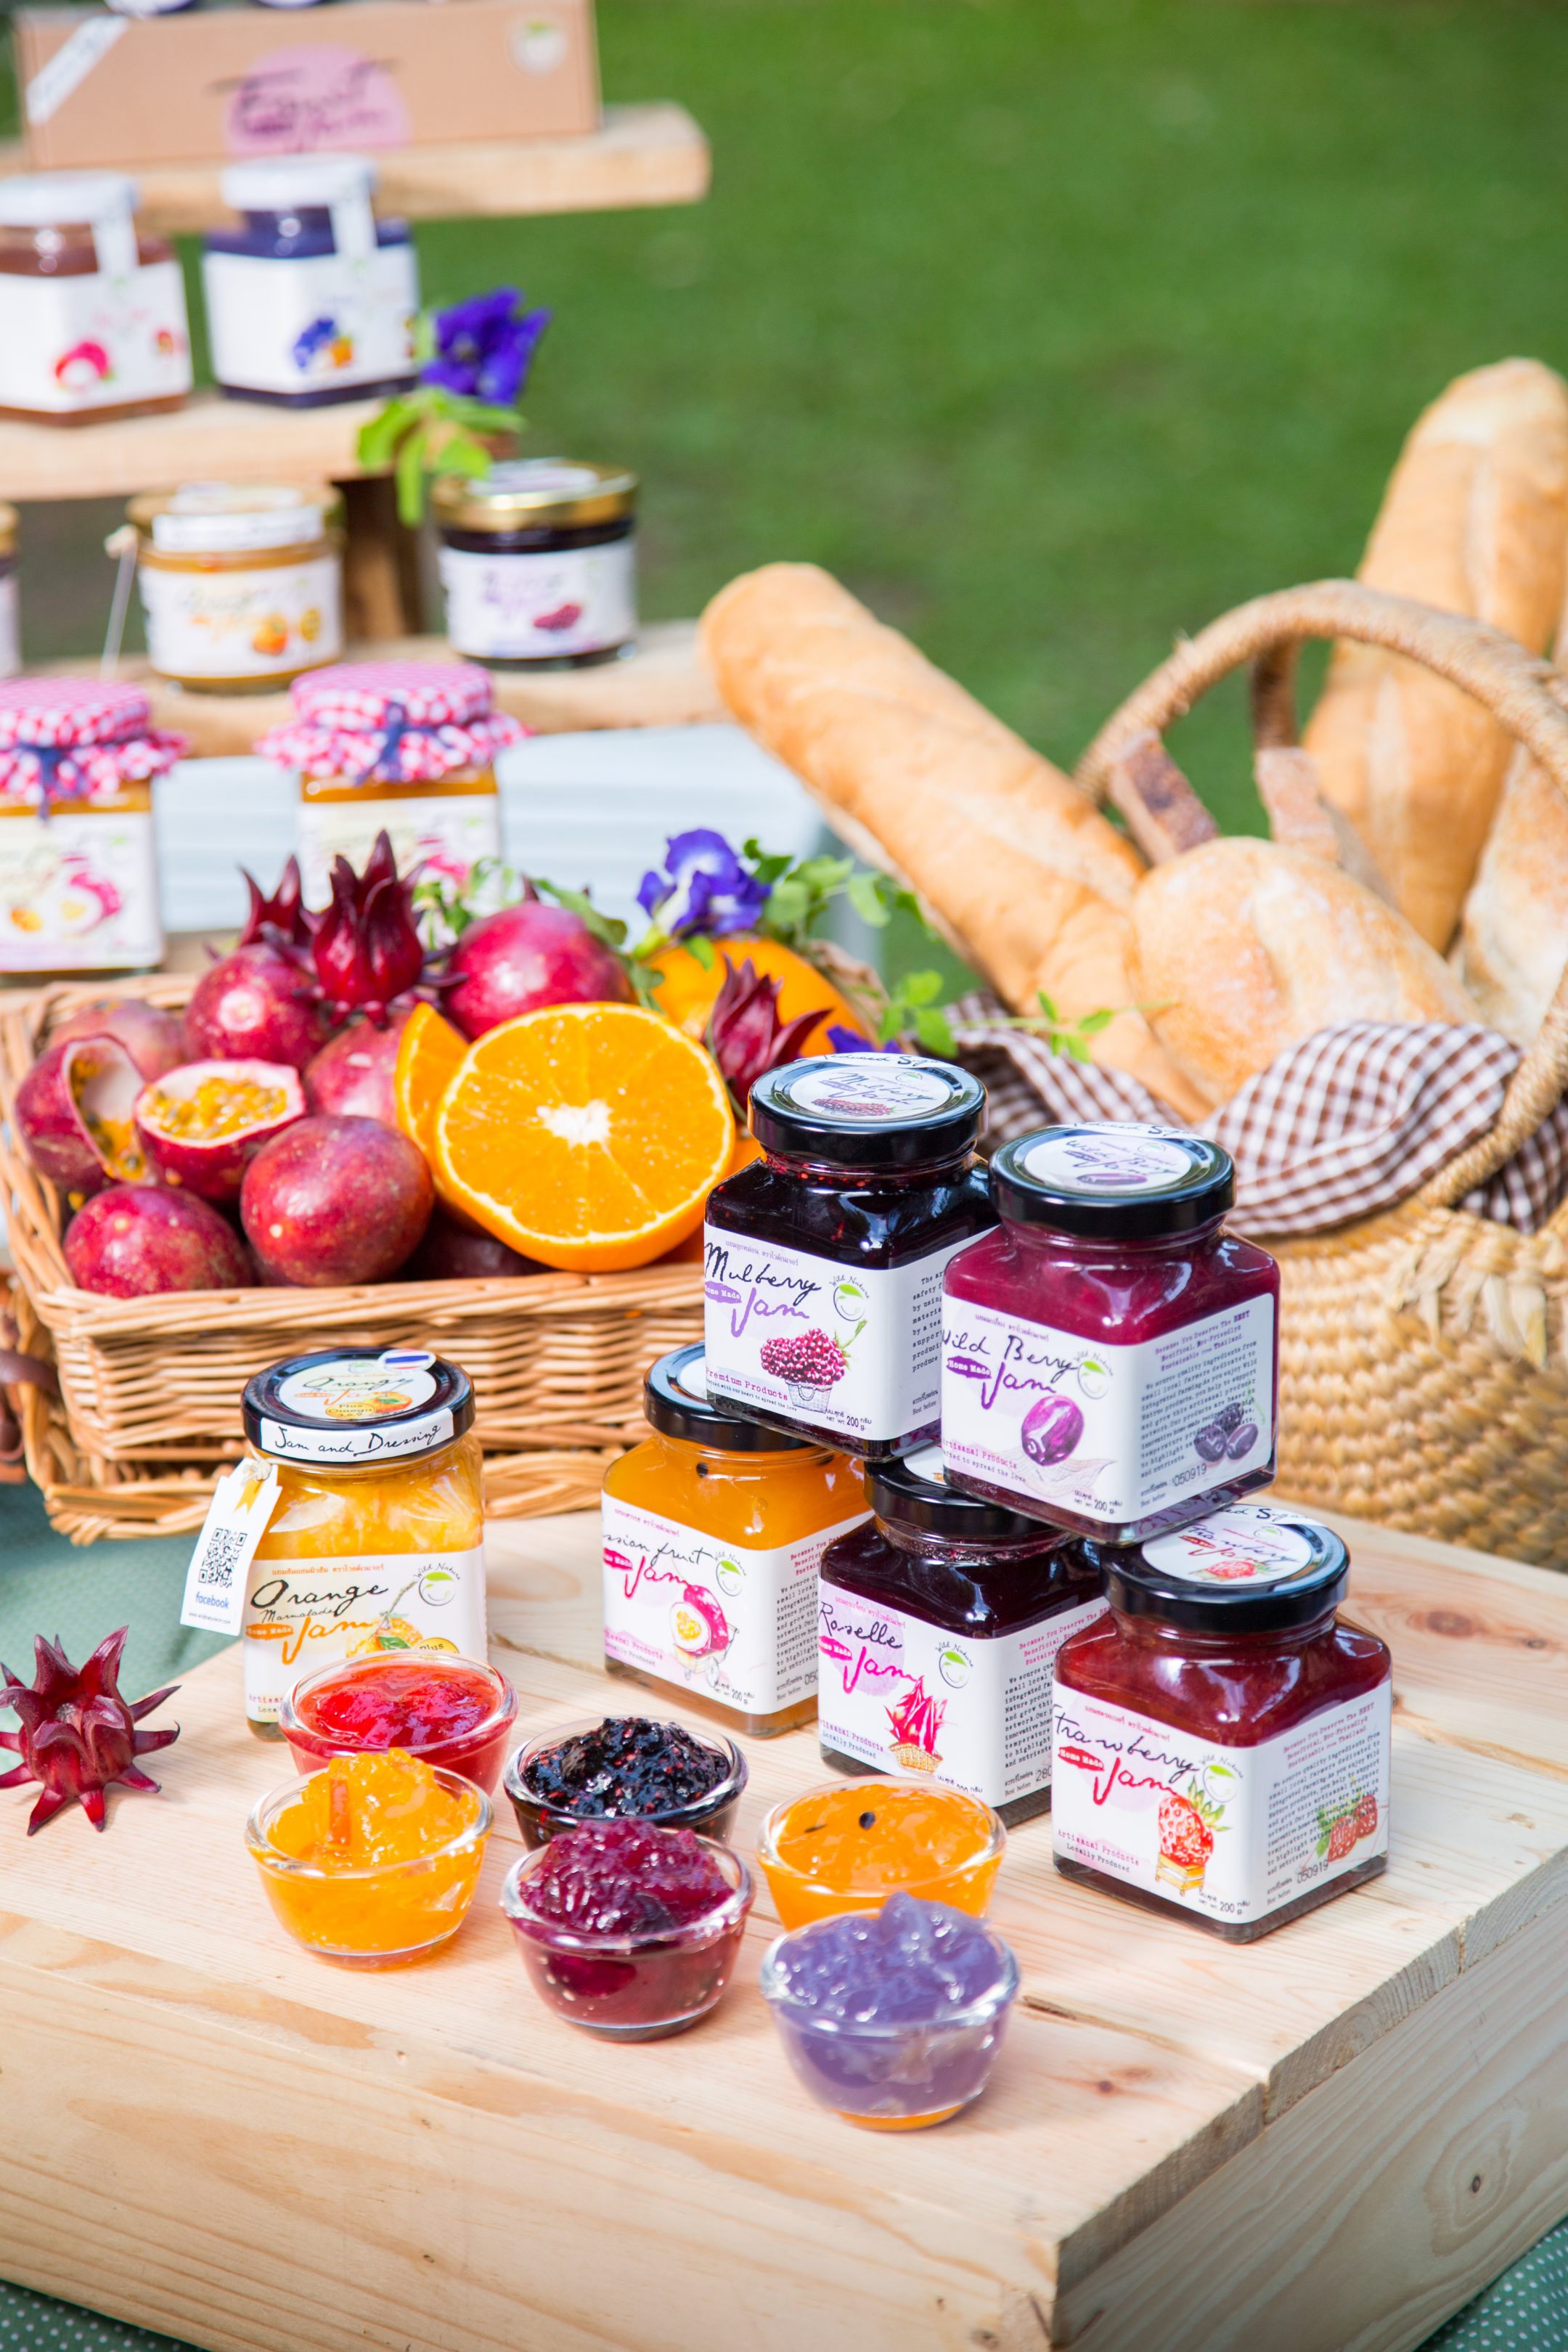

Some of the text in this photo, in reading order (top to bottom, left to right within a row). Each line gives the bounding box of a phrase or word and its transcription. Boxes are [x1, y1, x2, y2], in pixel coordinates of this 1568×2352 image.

[704, 1242, 821, 1306] Mulberry
[920, 1275, 933, 1285] The
[721, 1289, 740, 1302] Made
[829, 1275, 870, 1299] Wild Nature
[912, 1286, 936, 1301] safety
[730, 1287, 809, 1338] Jam
[912, 1304, 921, 1312] by
[912, 1307, 942, 1324] materia
[1181, 1335, 1193, 1344] You
[1220, 1320, 1232, 1328] The
[1233, 1310, 1250, 1323] BEST
[912, 1355, 938, 1373] produce
[942, 1329, 1078, 1384] Wild Berry
[948, 1357, 991, 1379] Home Made
[303, 1376, 415, 1391] Orange
[745, 1381, 788, 1401] Products
[981, 1362, 1056, 1410] Jam
[761, 1397, 777, 1405] spread
[912, 1400, 936, 1416] Best before
[846, 1415, 859, 1428] 200
[274, 1424, 441, 1457] Jam and Dressing
[946, 1441, 1017, 1469] rtisanal Products
[971, 1461, 995, 1473] spread
[997, 1469, 1008, 1477] the
[1174, 1462, 1207, 1487] 050919
[1094, 1498, 1107, 1512] 200
[602, 1534, 713, 1569] ssion fruit
[790, 1541, 827, 1561] Because You
[413, 1562, 461, 1581] Wild Nature
[624, 1556, 692, 1598] Jam
[776, 1583, 816, 1604] small local
[789, 1577, 810, 1591] source
[195, 1592, 230, 1609] facebook
[250, 1579, 388, 1617] Orange
[777, 1593, 810, 1614] integrated
[258, 1609, 336, 1623] Marmalade
[777, 1609, 797, 1622] Nature
[789, 1614, 804, 1627] grow
[819, 1601, 902, 1650] Roselle
[281, 1617, 372, 1666] Jam
[777, 1631, 807, 1649] innovative
[1018, 1636, 1045, 1650] Because
[1046, 1629, 1058, 1638] You
[1058, 1618, 1085, 1633] Deserve
[776, 1635, 817, 1658] temperature
[785, 1643, 818, 1662] highlight
[833, 1644, 852, 1658] Made
[935, 1641, 974, 1668] Wild Nature
[1024, 1637, 1062, 1657] Beneficial,
[843, 1646, 919, 1694] Jam
[1018, 1667, 1041, 1681] source
[1005, 1673, 1048, 1695] small local
[1005, 1684, 1042, 1704] integrated
[249, 1694, 282, 1703] Artisa
[731, 1689, 743, 1702] 200
[1005, 1690, 1052, 1714] Nature produc
[1005, 1706, 1036, 1723] and grow
[820, 1719, 883, 1752] rtisanal Products
[1005, 1723, 1038, 1741] innovative
[1005, 1728, 1050, 1749] temperature
[822, 1731, 876, 1759] Locally Produced
[1015, 1736, 1050, 1755] highlight
[1053, 1704, 1200, 1784] trawberry
[1005, 1745, 1052, 1768] and nutrients
[1059, 1747, 1104, 1771] Home Made
[1004, 1765, 1051, 1797] Best before 280
[1093, 1757, 1177, 1805] Jam
[1058, 1830, 1139, 1866] Artisanal Products
[1066, 1843, 1130, 1873] Locally Produced
[1297, 1858, 1328, 1884] 050919
[1220, 1900, 1235, 1914] 200
